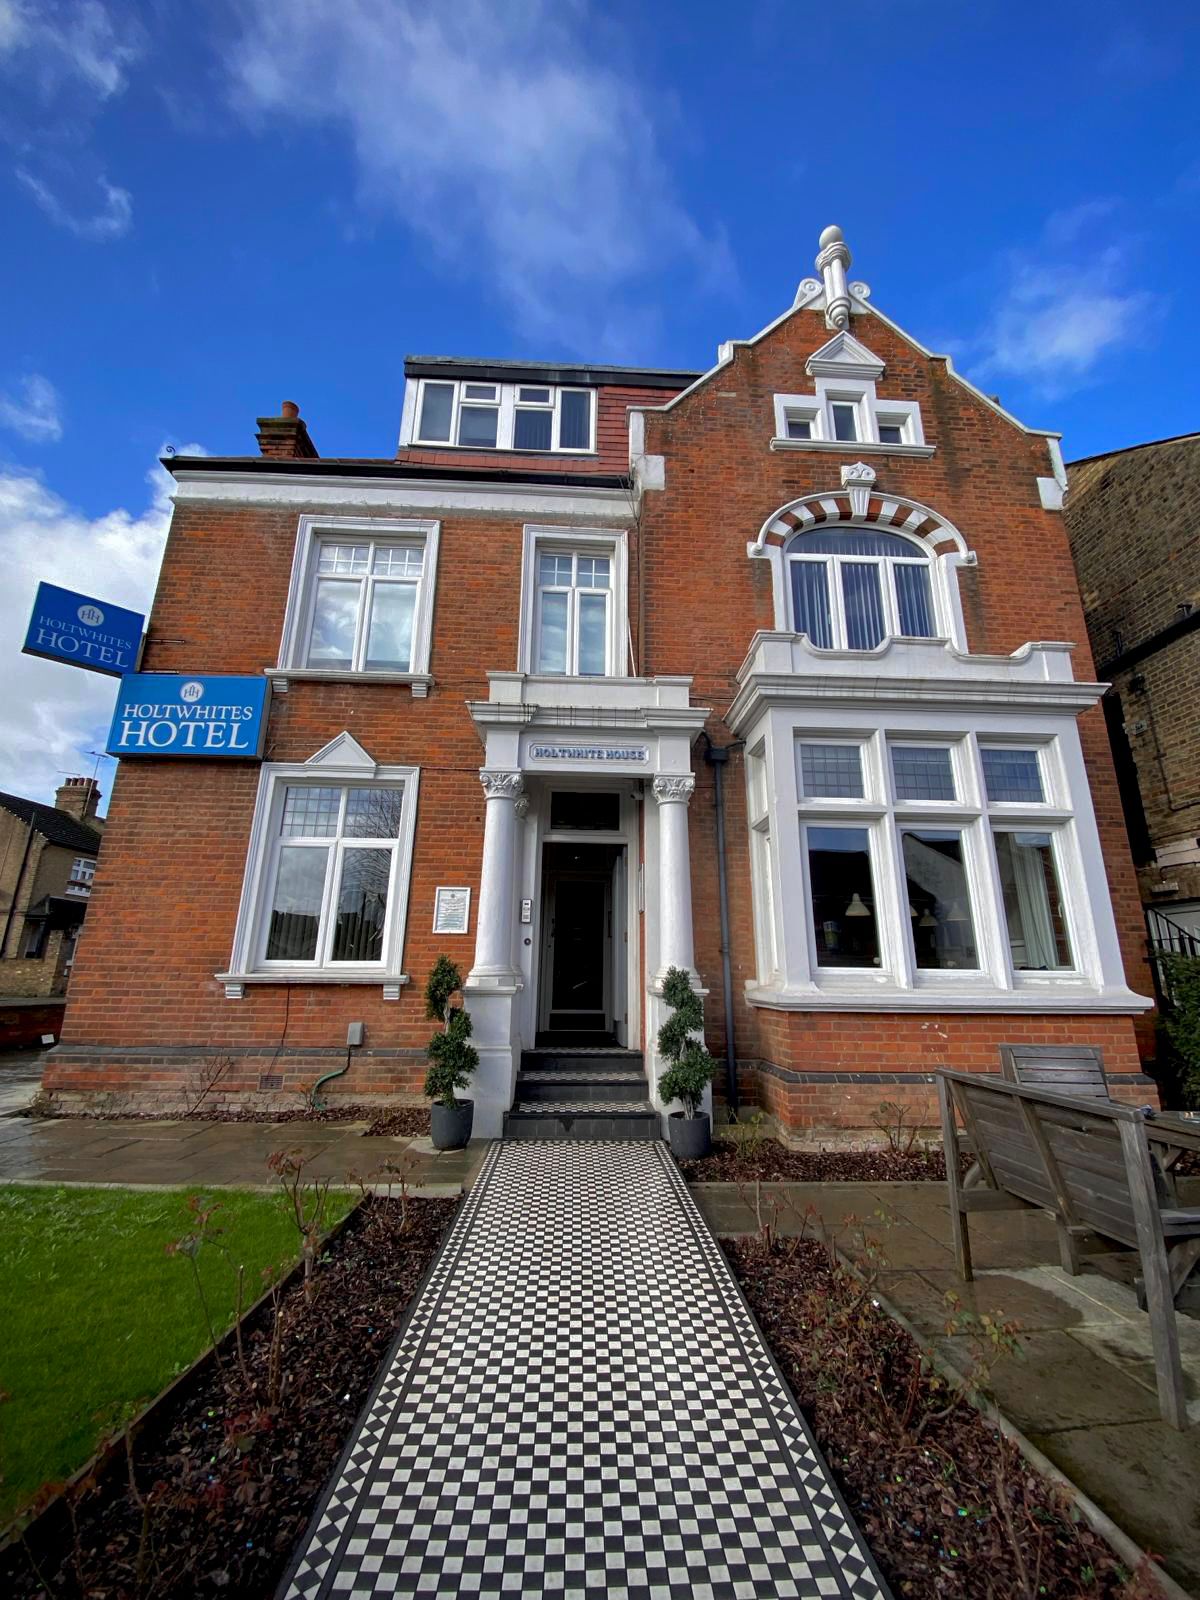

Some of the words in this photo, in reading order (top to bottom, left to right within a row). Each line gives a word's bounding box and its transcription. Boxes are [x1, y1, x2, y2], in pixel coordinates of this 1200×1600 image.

[39, 616, 132, 649] HOLTWHITES
[36, 628, 129, 668] HOTEL
[123, 704, 253, 721] HOLTWHITES
[118, 721, 249, 749] HOTEL
[535, 747, 603, 760] HOLTWHITE
[606, 749, 645, 761] HOUSE
